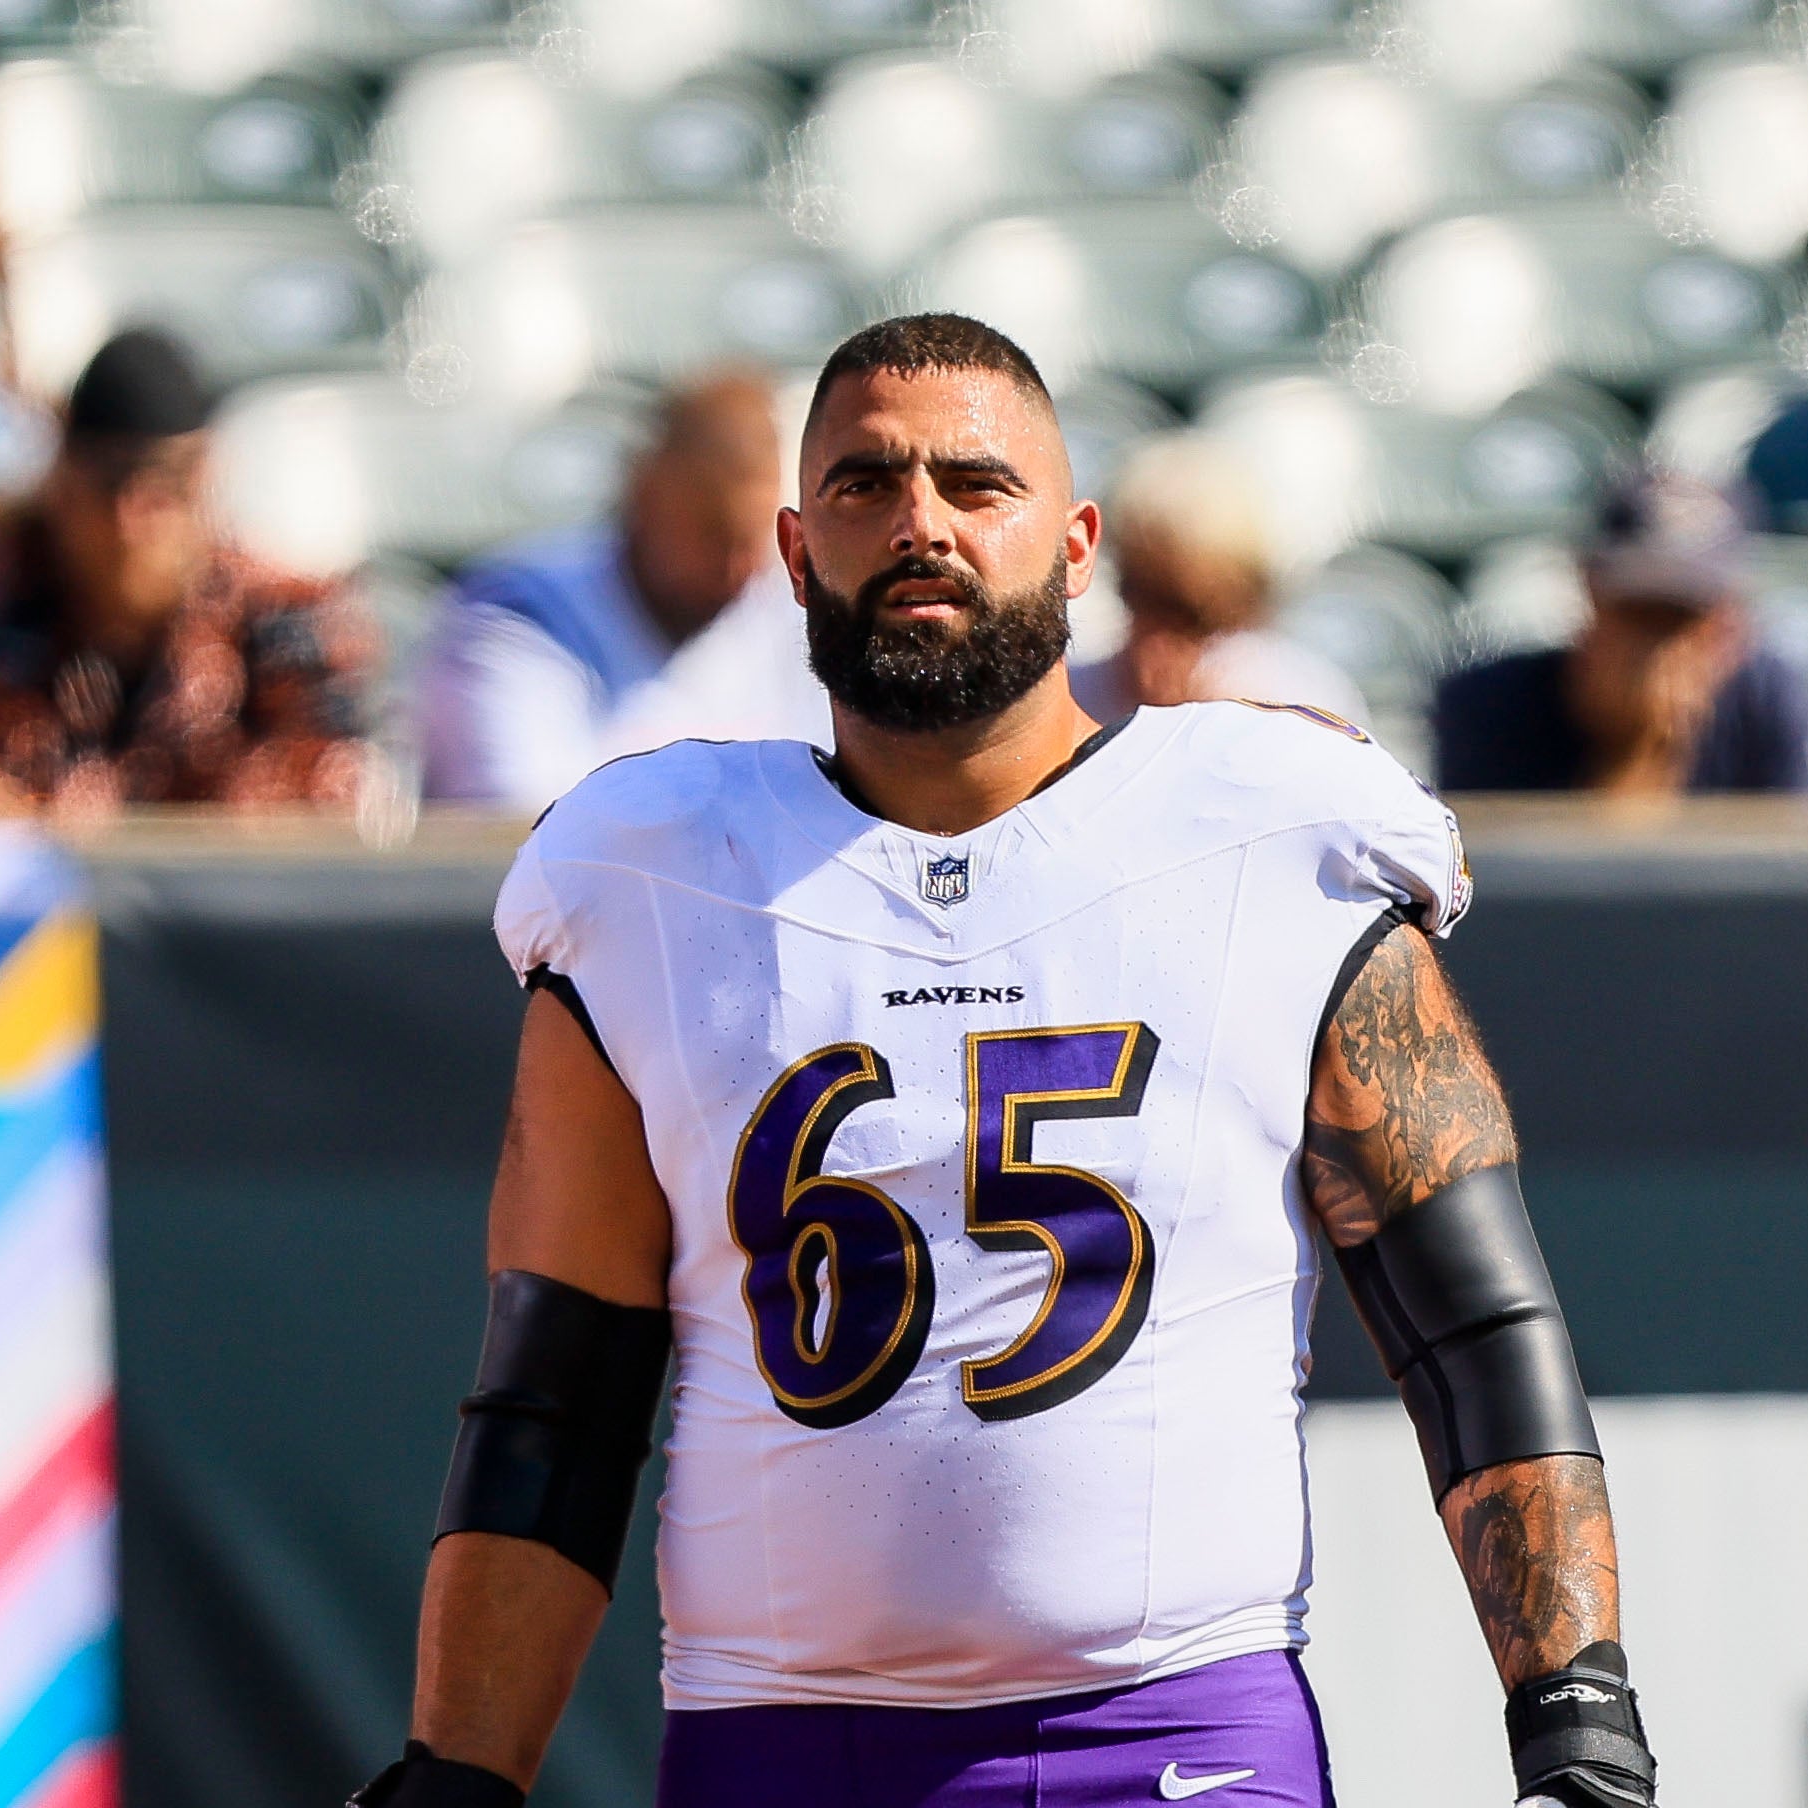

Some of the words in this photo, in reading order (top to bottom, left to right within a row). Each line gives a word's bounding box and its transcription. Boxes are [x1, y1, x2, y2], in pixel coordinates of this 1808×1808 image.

[927, 873, 966, 898] NFL
[881, 985, 1026, 1008] RAVENS
[727, 1021, 1161, 1430] 65
